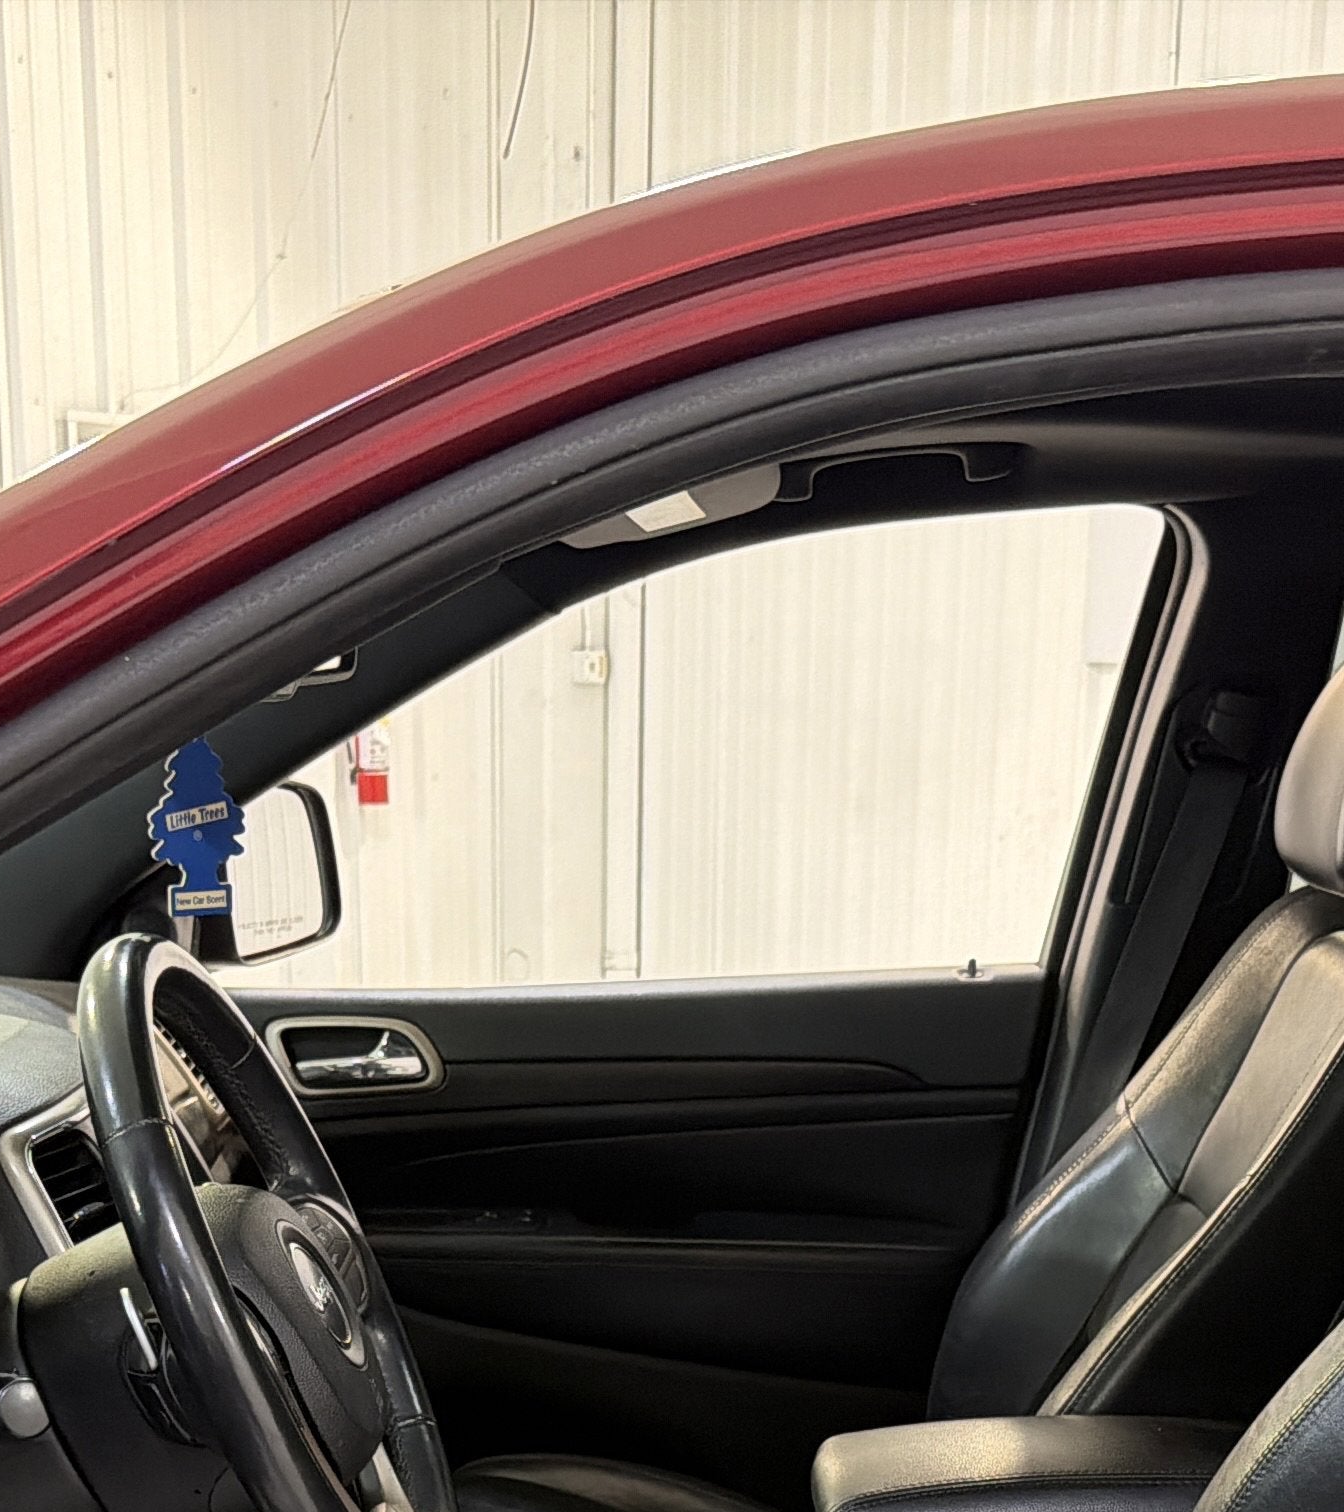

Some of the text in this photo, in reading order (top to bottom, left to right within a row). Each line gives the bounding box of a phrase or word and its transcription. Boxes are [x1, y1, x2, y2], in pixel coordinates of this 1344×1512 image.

[169, 807, 225, 829] Little Trees
[176, 895, 225, 905] New Car Scent
